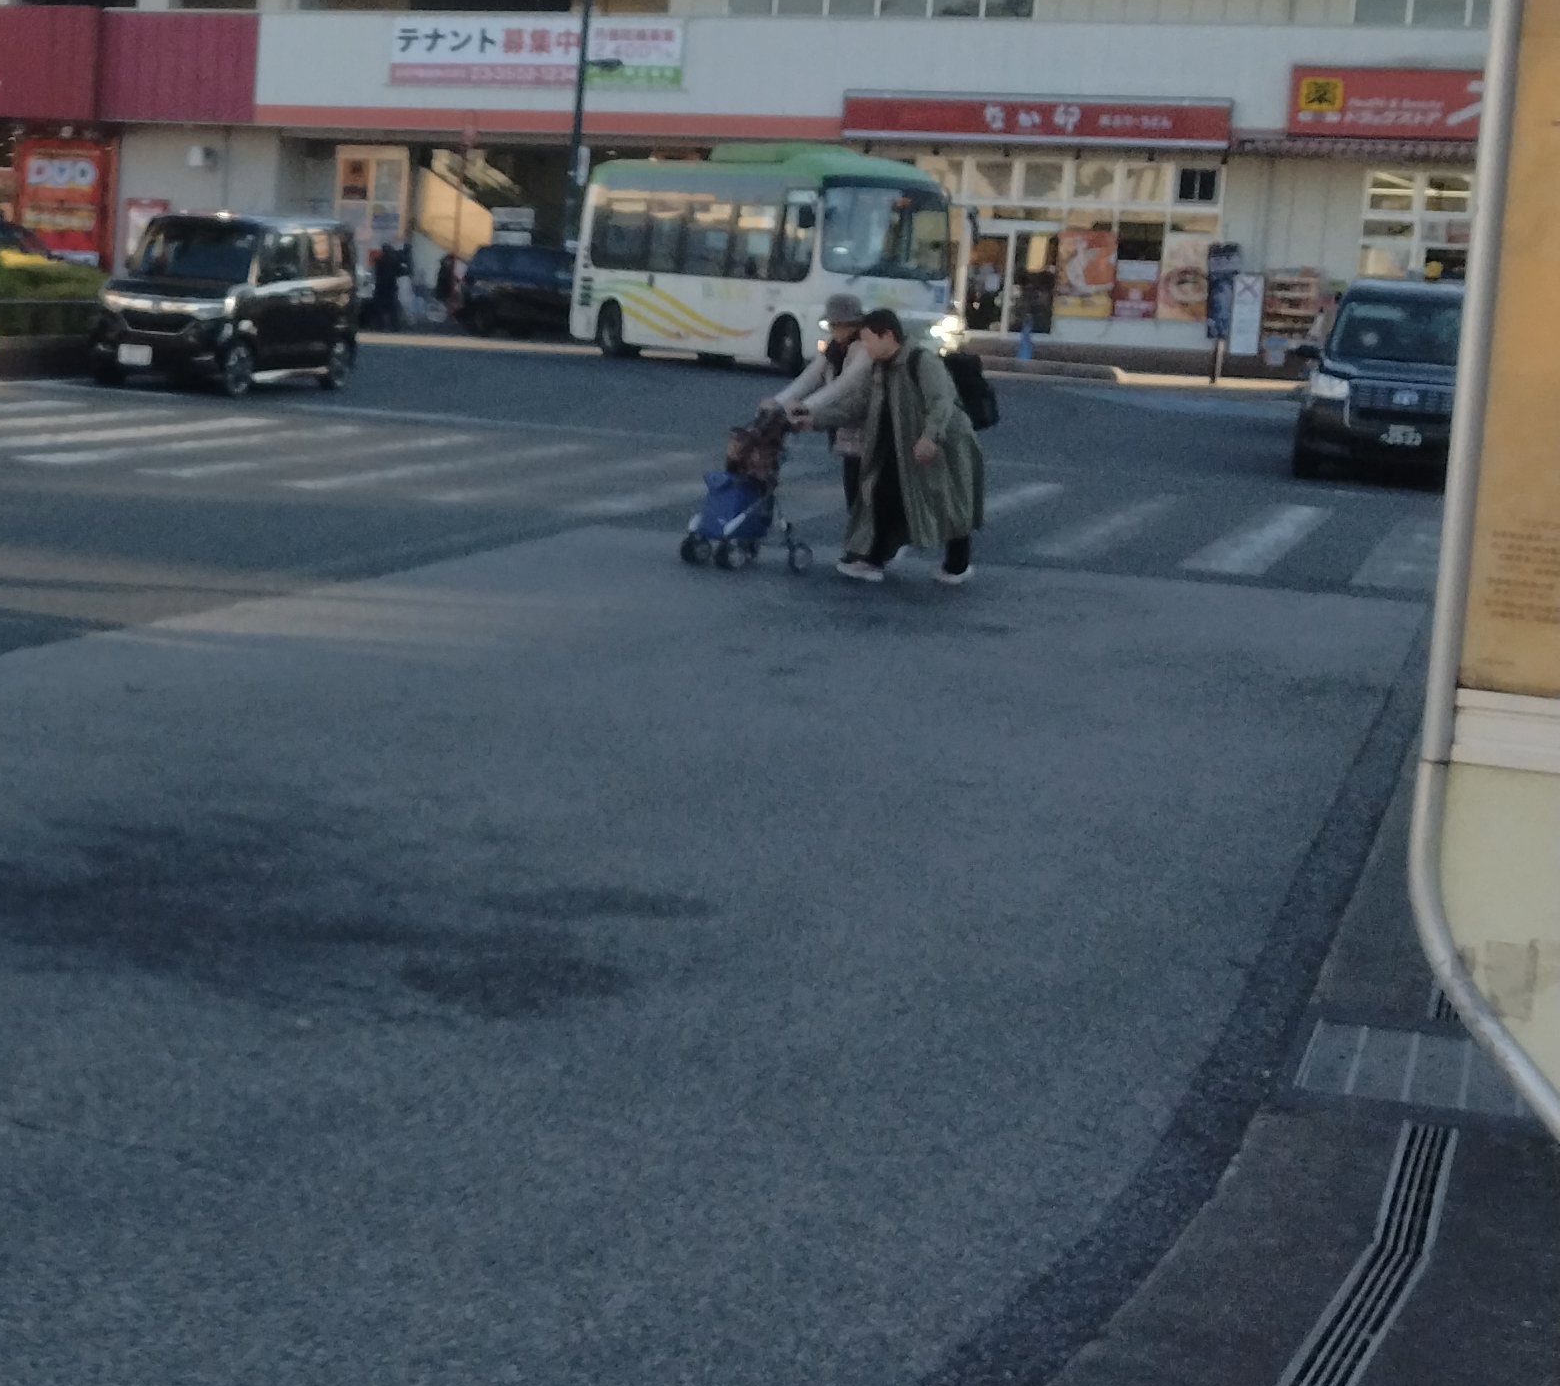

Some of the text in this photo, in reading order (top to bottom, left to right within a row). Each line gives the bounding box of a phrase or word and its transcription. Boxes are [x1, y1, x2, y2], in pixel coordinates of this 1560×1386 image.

[397, 27, 581, 55] テナント募集中
[27, 158, 97, 188] DUO
